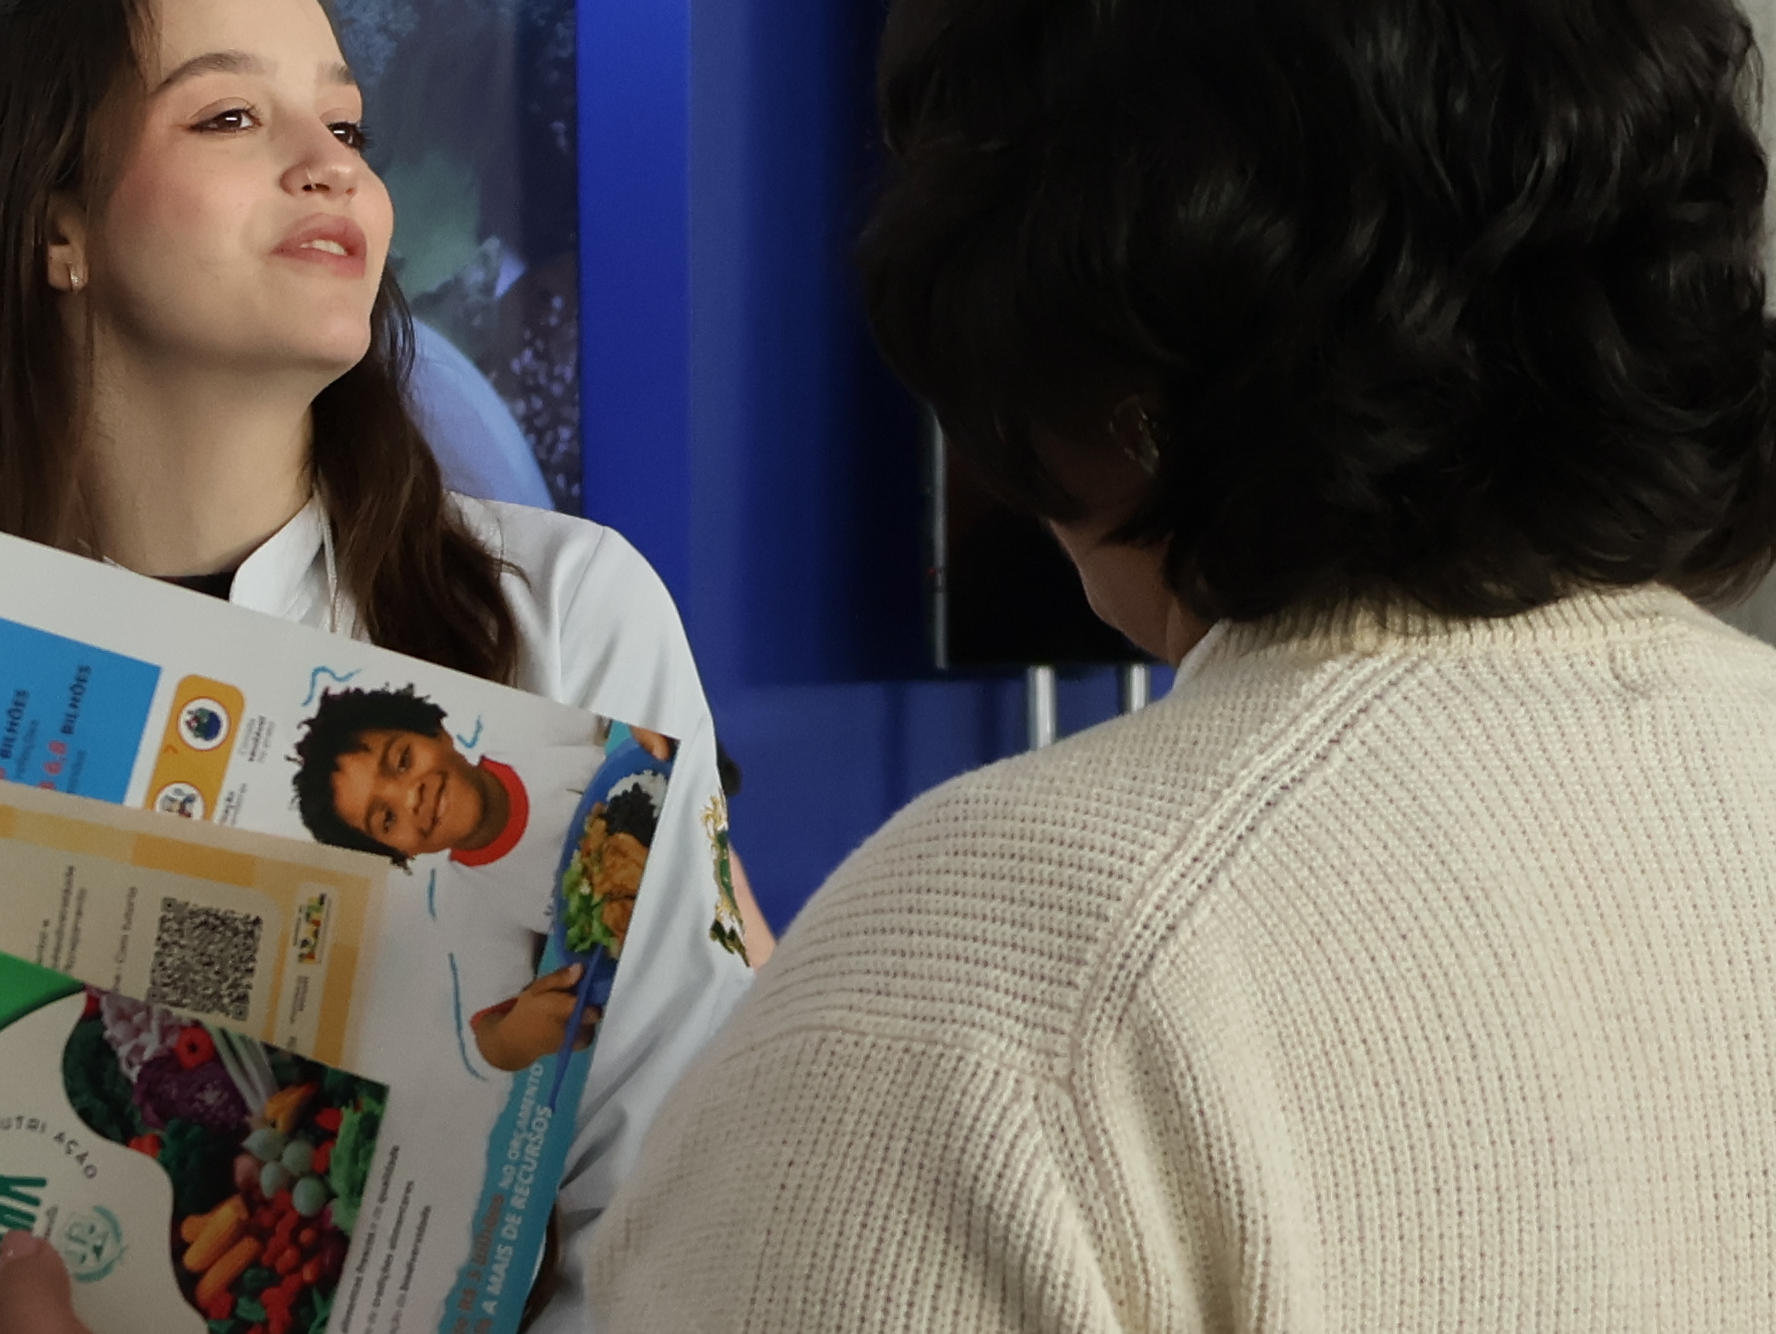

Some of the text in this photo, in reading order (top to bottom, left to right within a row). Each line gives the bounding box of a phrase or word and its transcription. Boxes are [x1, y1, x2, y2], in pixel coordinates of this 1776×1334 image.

[497, 1162, 517, 1190] NO
[507, 1060, 544, 1161] ORÇAMENTO
[53, 1132, 97, 1179] AÇÃO
[510, 1104, 554, 1209] RECURSOS
[501, 1212, 522, 1240] DE
[486, 1243, 513, 1295] MAIS
[481, 1299, 498, 1315] A
